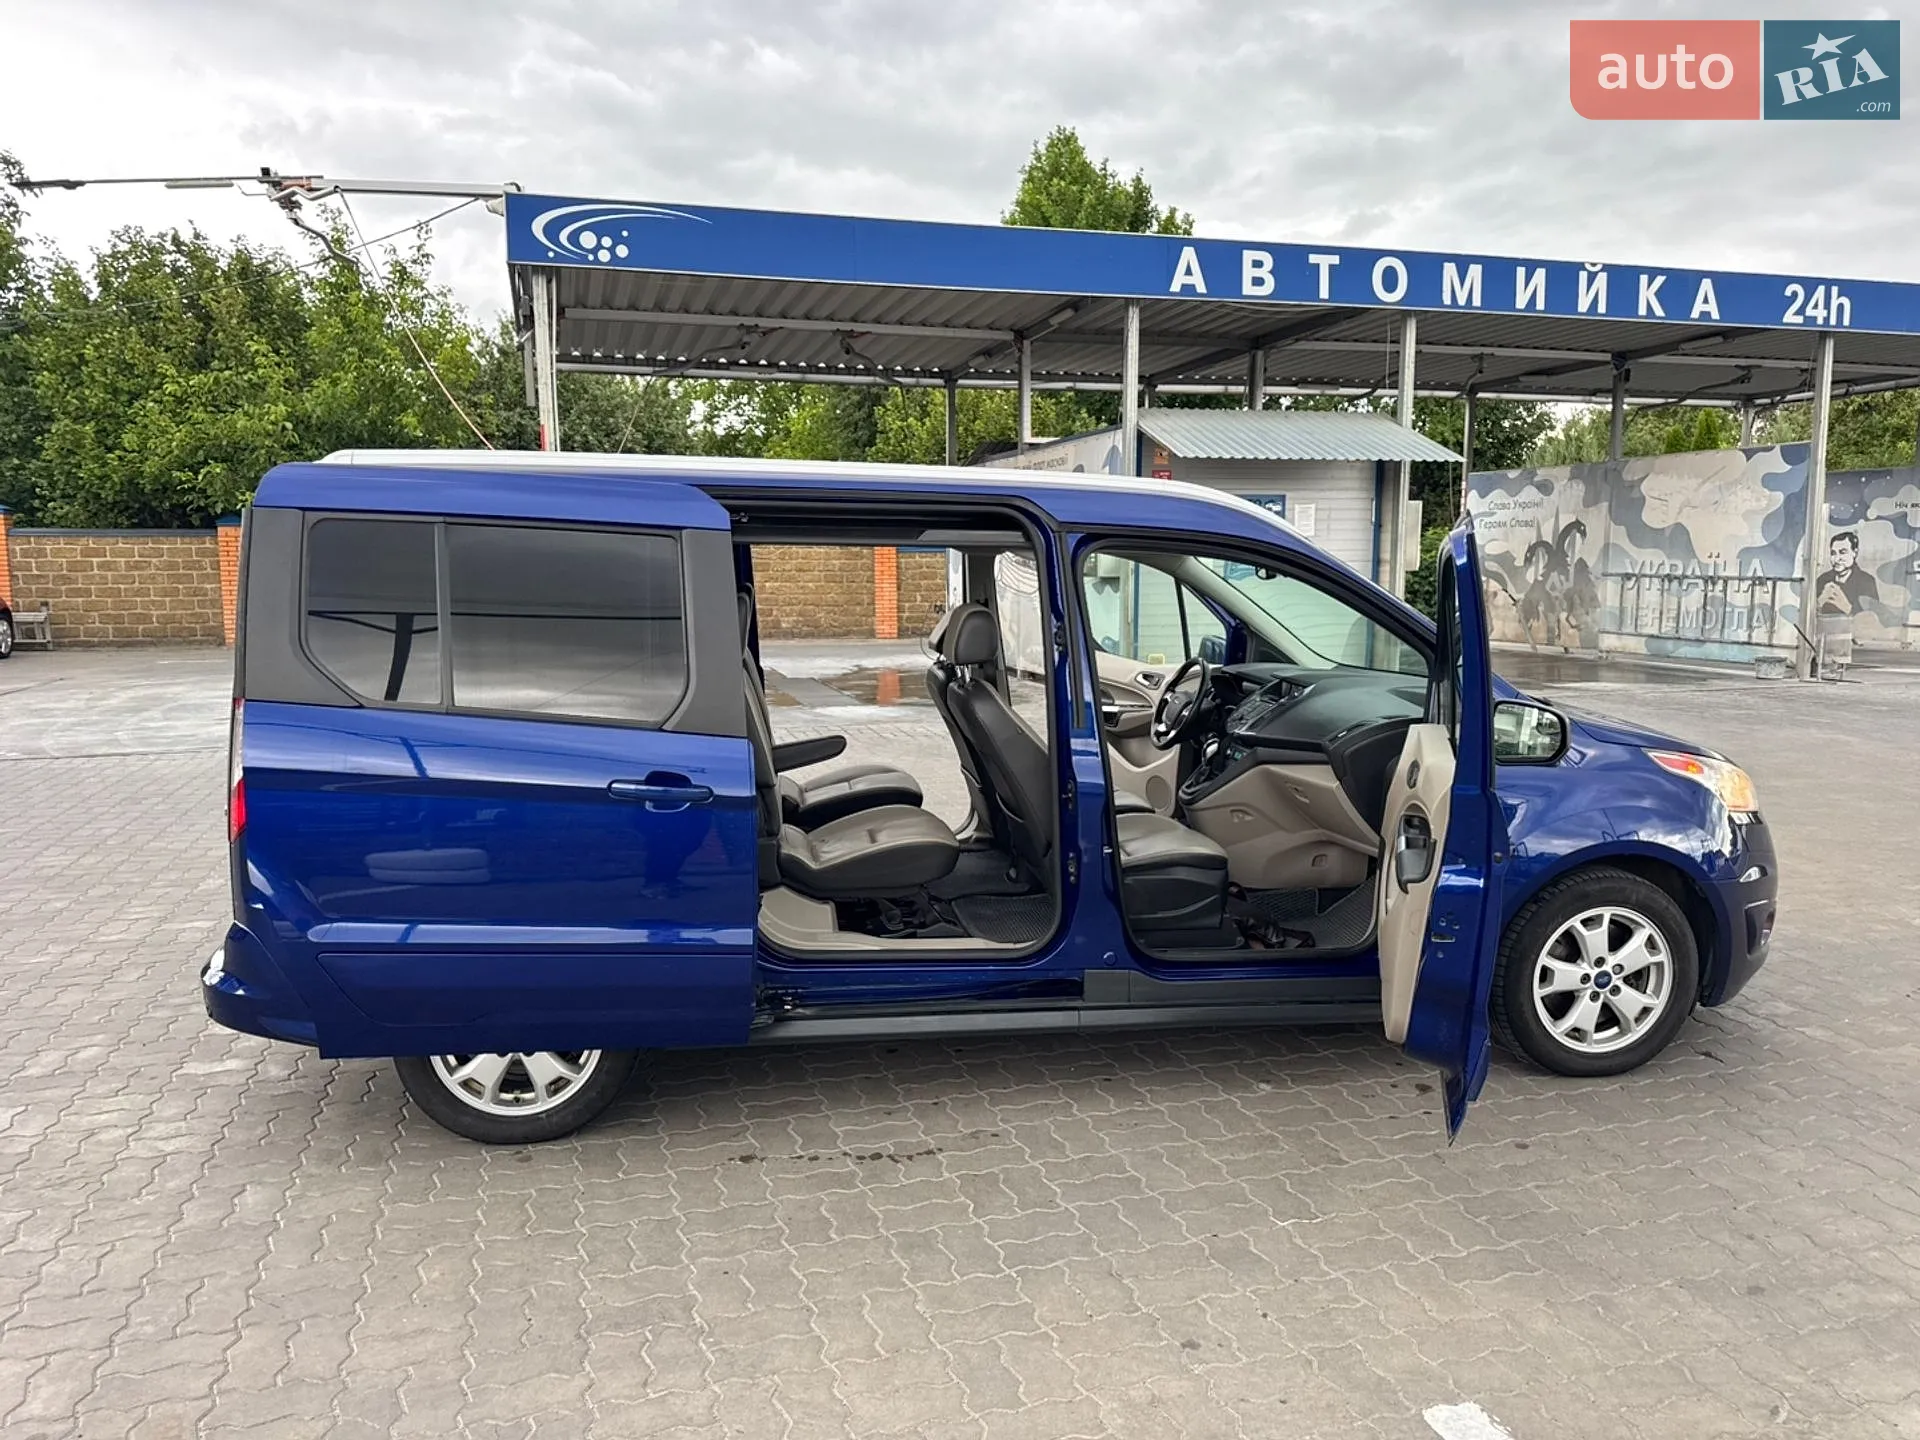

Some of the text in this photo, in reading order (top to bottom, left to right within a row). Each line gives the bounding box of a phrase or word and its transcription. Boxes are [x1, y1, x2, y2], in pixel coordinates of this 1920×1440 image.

[1169, 246, 1851, 327] АВТОМИЙКА 24h
[1624, 551, 1770, 594] УКРАЇНА
